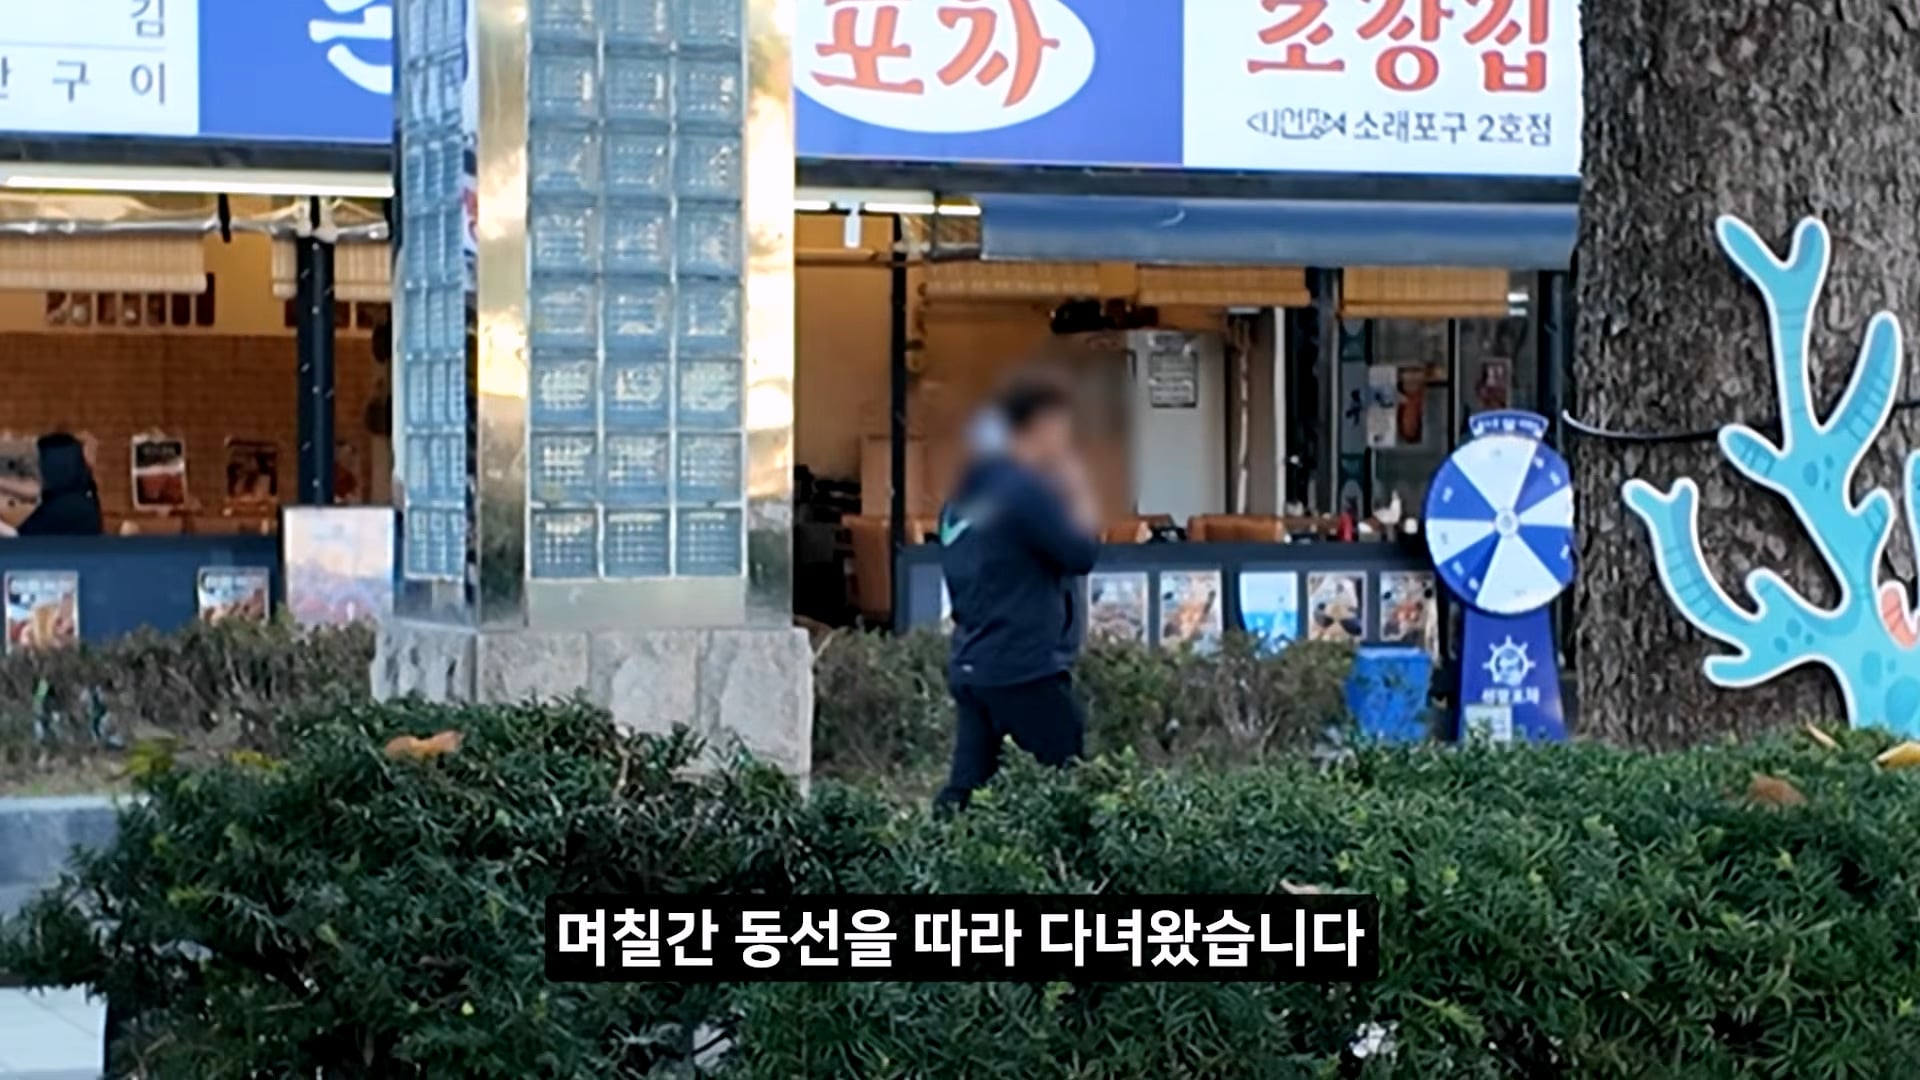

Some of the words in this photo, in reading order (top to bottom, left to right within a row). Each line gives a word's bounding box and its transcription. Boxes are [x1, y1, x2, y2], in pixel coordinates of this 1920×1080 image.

[810, 0, 1060, 107] 포차
[1353, 111, 1467, 144] 소래포구
[1478, 112, 1552, 146] 2호점
